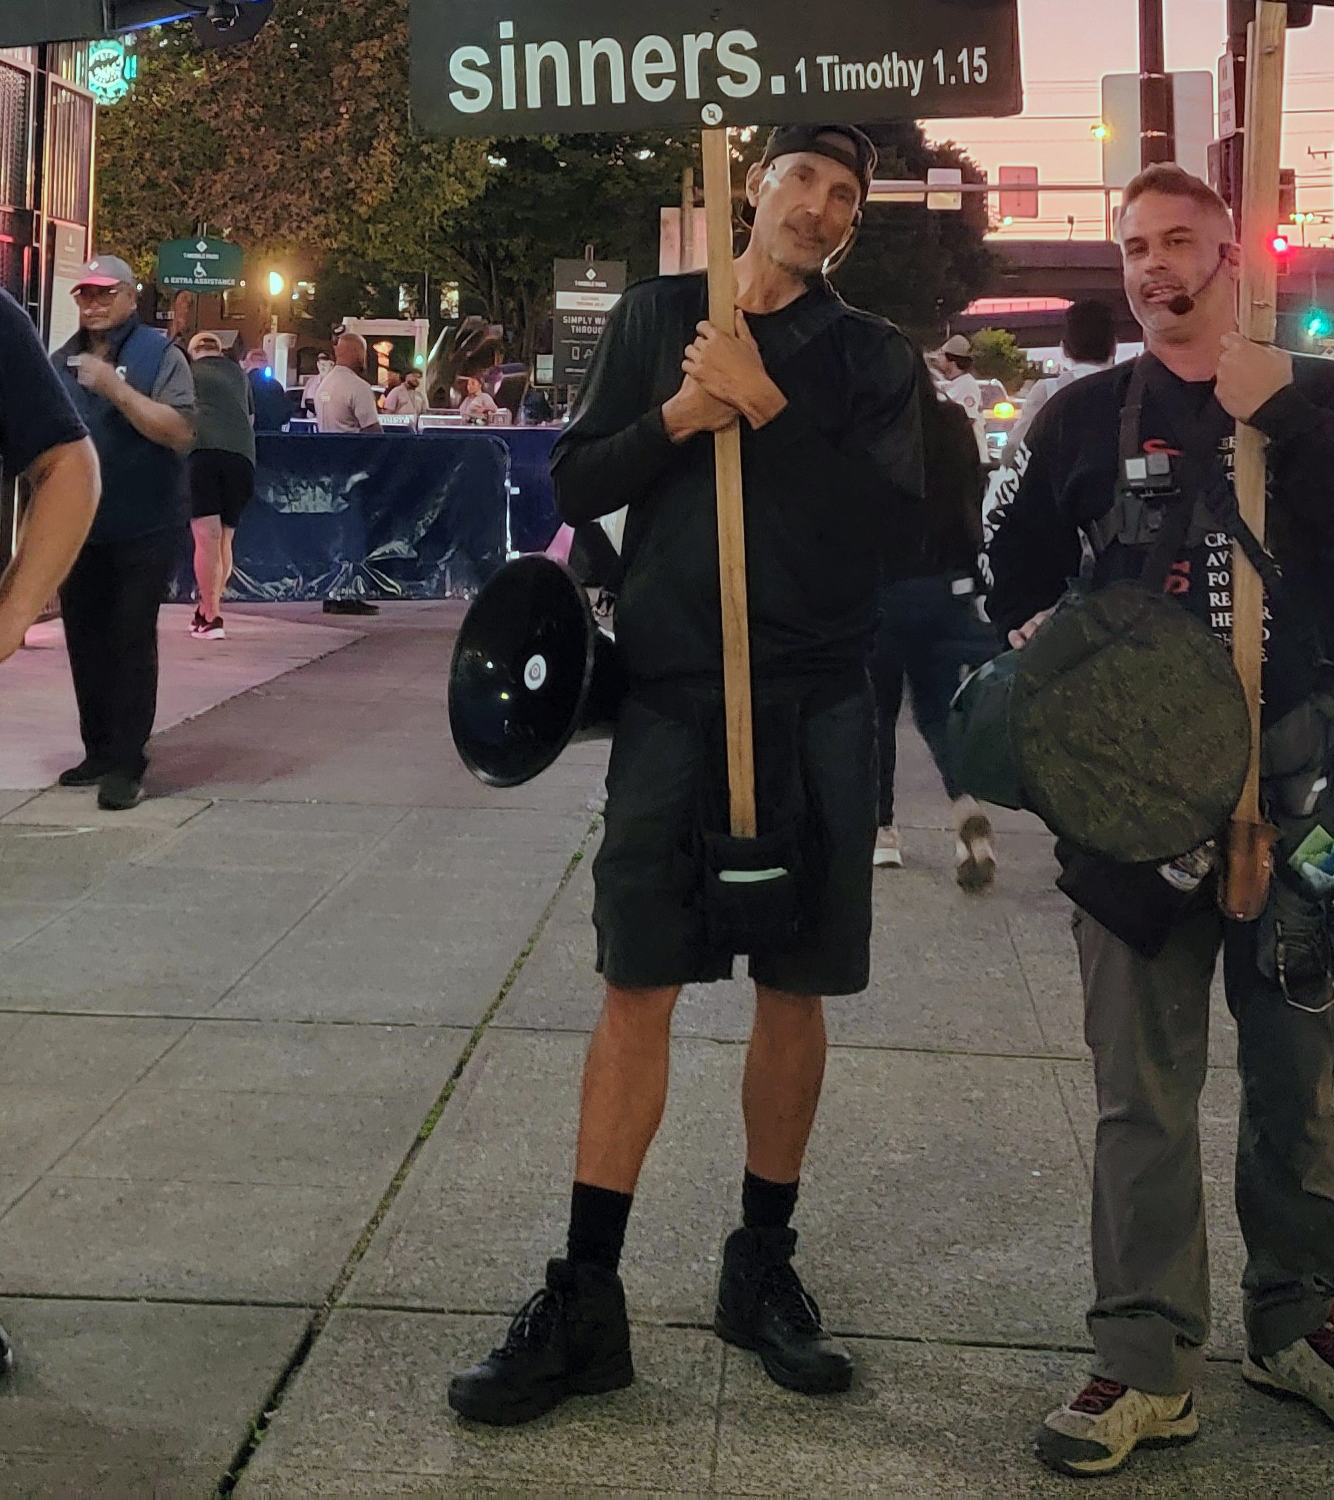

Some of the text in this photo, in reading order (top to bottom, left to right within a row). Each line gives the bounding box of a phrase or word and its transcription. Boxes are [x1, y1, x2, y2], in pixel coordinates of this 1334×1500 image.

[448, 20, 786, 114] sinners.
[794, 57, 807, 93] 1
[817, 49, 924, 97] Timothy
[563, 316, 593, 325] SIMPLY
[571, 325, 603, 334] THROUG
